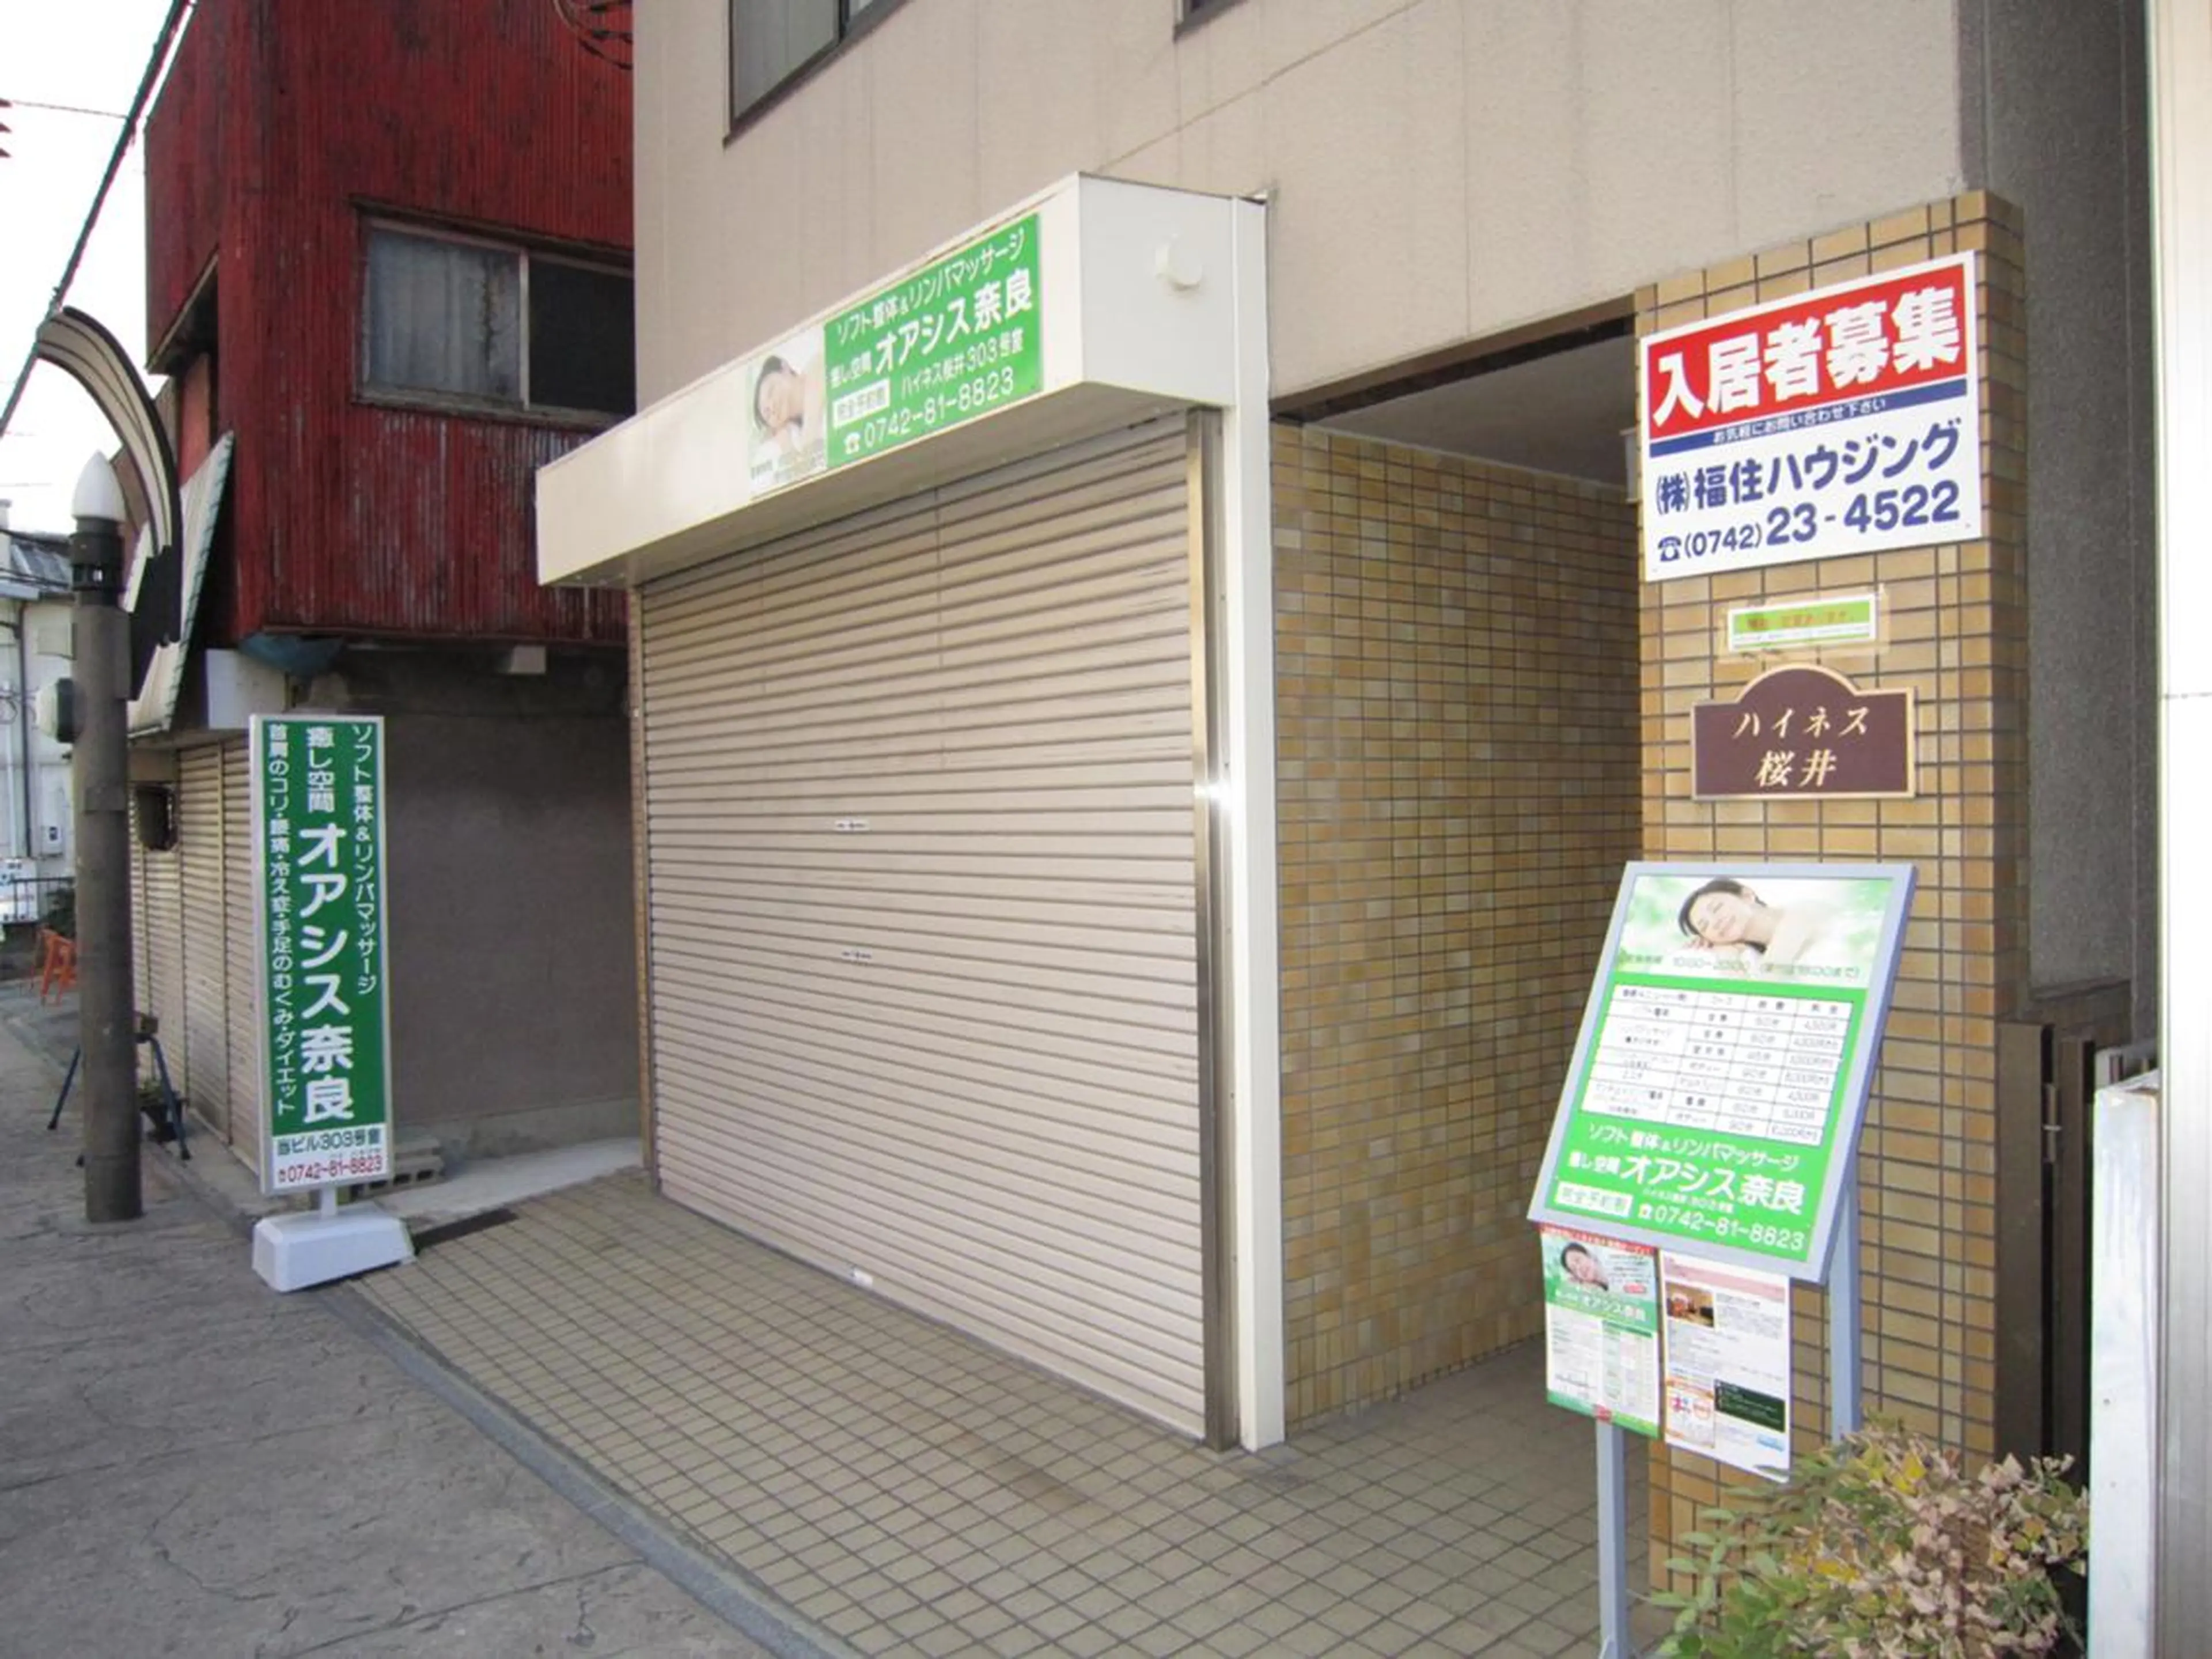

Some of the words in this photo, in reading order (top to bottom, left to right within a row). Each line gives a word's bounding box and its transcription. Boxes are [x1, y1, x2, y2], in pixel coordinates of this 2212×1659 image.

[876, 267, 1032, 374] オアシス奈良
[1653, 286, 1960, 427] 入居者募集
[1732, 706, 1869, 739] ハイネス
[1755, 749, 1837, 787] 桜井
[297, 822, 355, 1123] オアシス奈良
[1620, 1153, 1805, 1215] オアシス奈良
